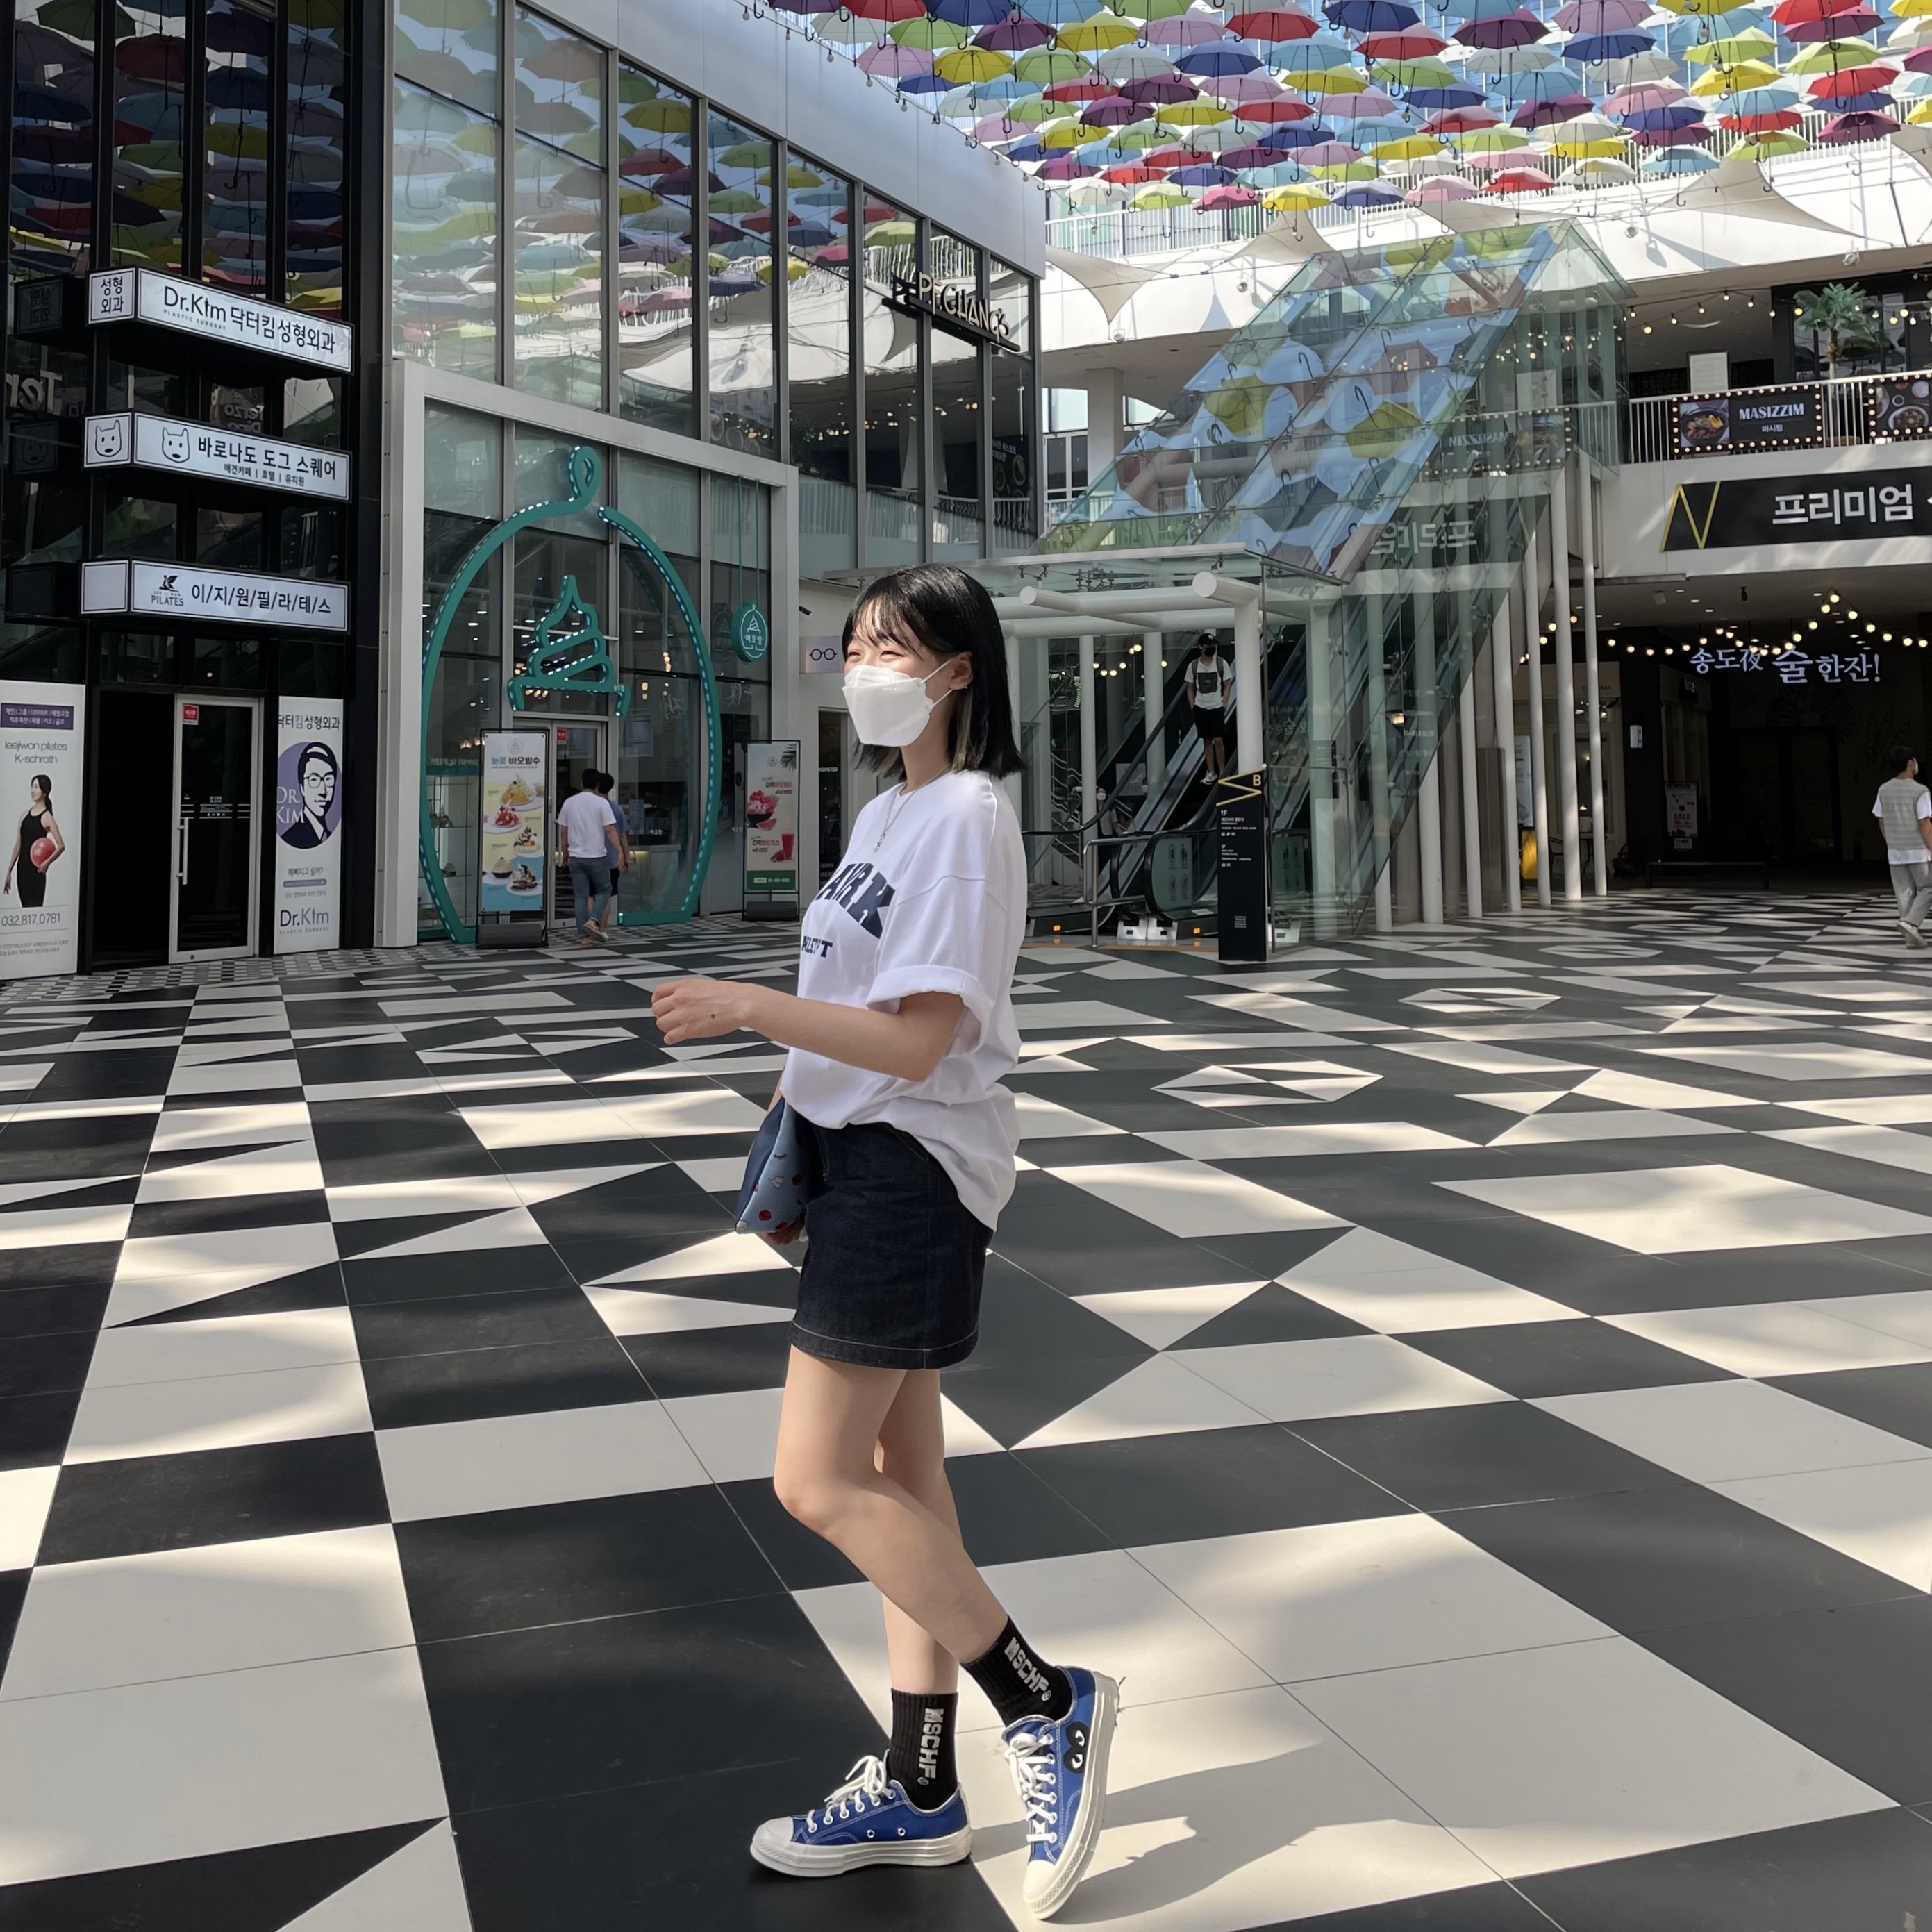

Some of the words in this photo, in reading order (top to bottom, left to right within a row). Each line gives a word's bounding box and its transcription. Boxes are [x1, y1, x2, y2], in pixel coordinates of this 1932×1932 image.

[101, 276, 123, 296] 성형
[101, 296, 124, 314] 외과
[1739, 403, 1805, 420] MASIZZIM
[198, 437, 257, 464] 바로나도
[263, 449, 290, 470] 도그
[296, 456, 335, 481] 스퀘어
[224, 463, 251, 477] 애견카페
[262, 469, 275, 481] 호텔
[285, 474, 304, 487] 유치원
[1772, 484, 1913, 525] 프리미엄
[151, 594, 184, 607] PILATES
[1772, 645, 1813, 684] 술
[15, 753, 58, 764] K-schroth
[1253, 774, 1261, 786] B
[815, 863, 896, 940] ARK
[1, 913, 60, 926] 032.817.0781
